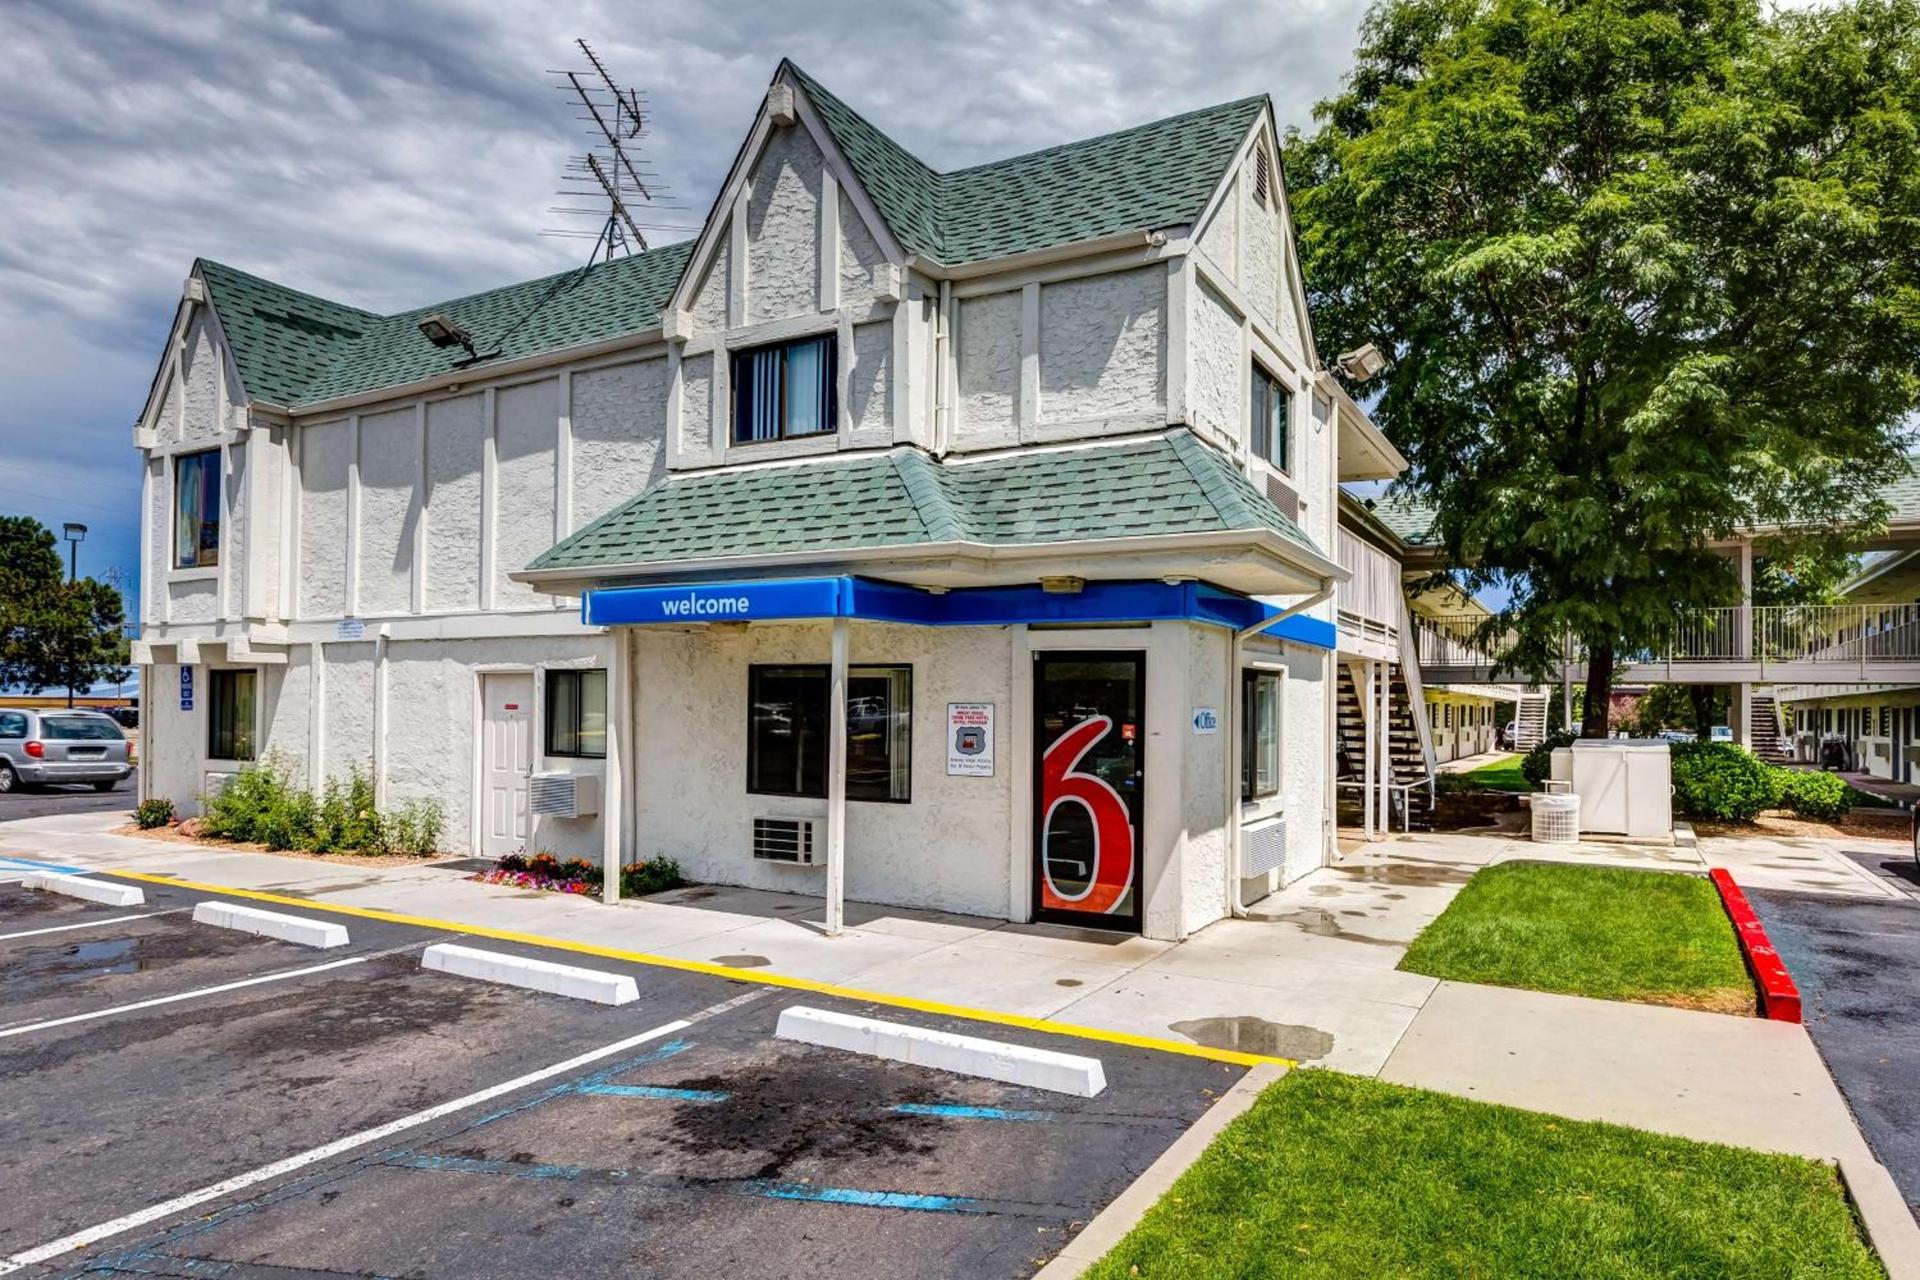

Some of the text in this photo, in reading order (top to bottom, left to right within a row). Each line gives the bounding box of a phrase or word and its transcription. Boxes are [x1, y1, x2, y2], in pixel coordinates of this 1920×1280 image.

[662, 592, 750, 616] welcome
[1200, 711, 1217, 729] Office
[1042, 715, 1135, 914] 6
